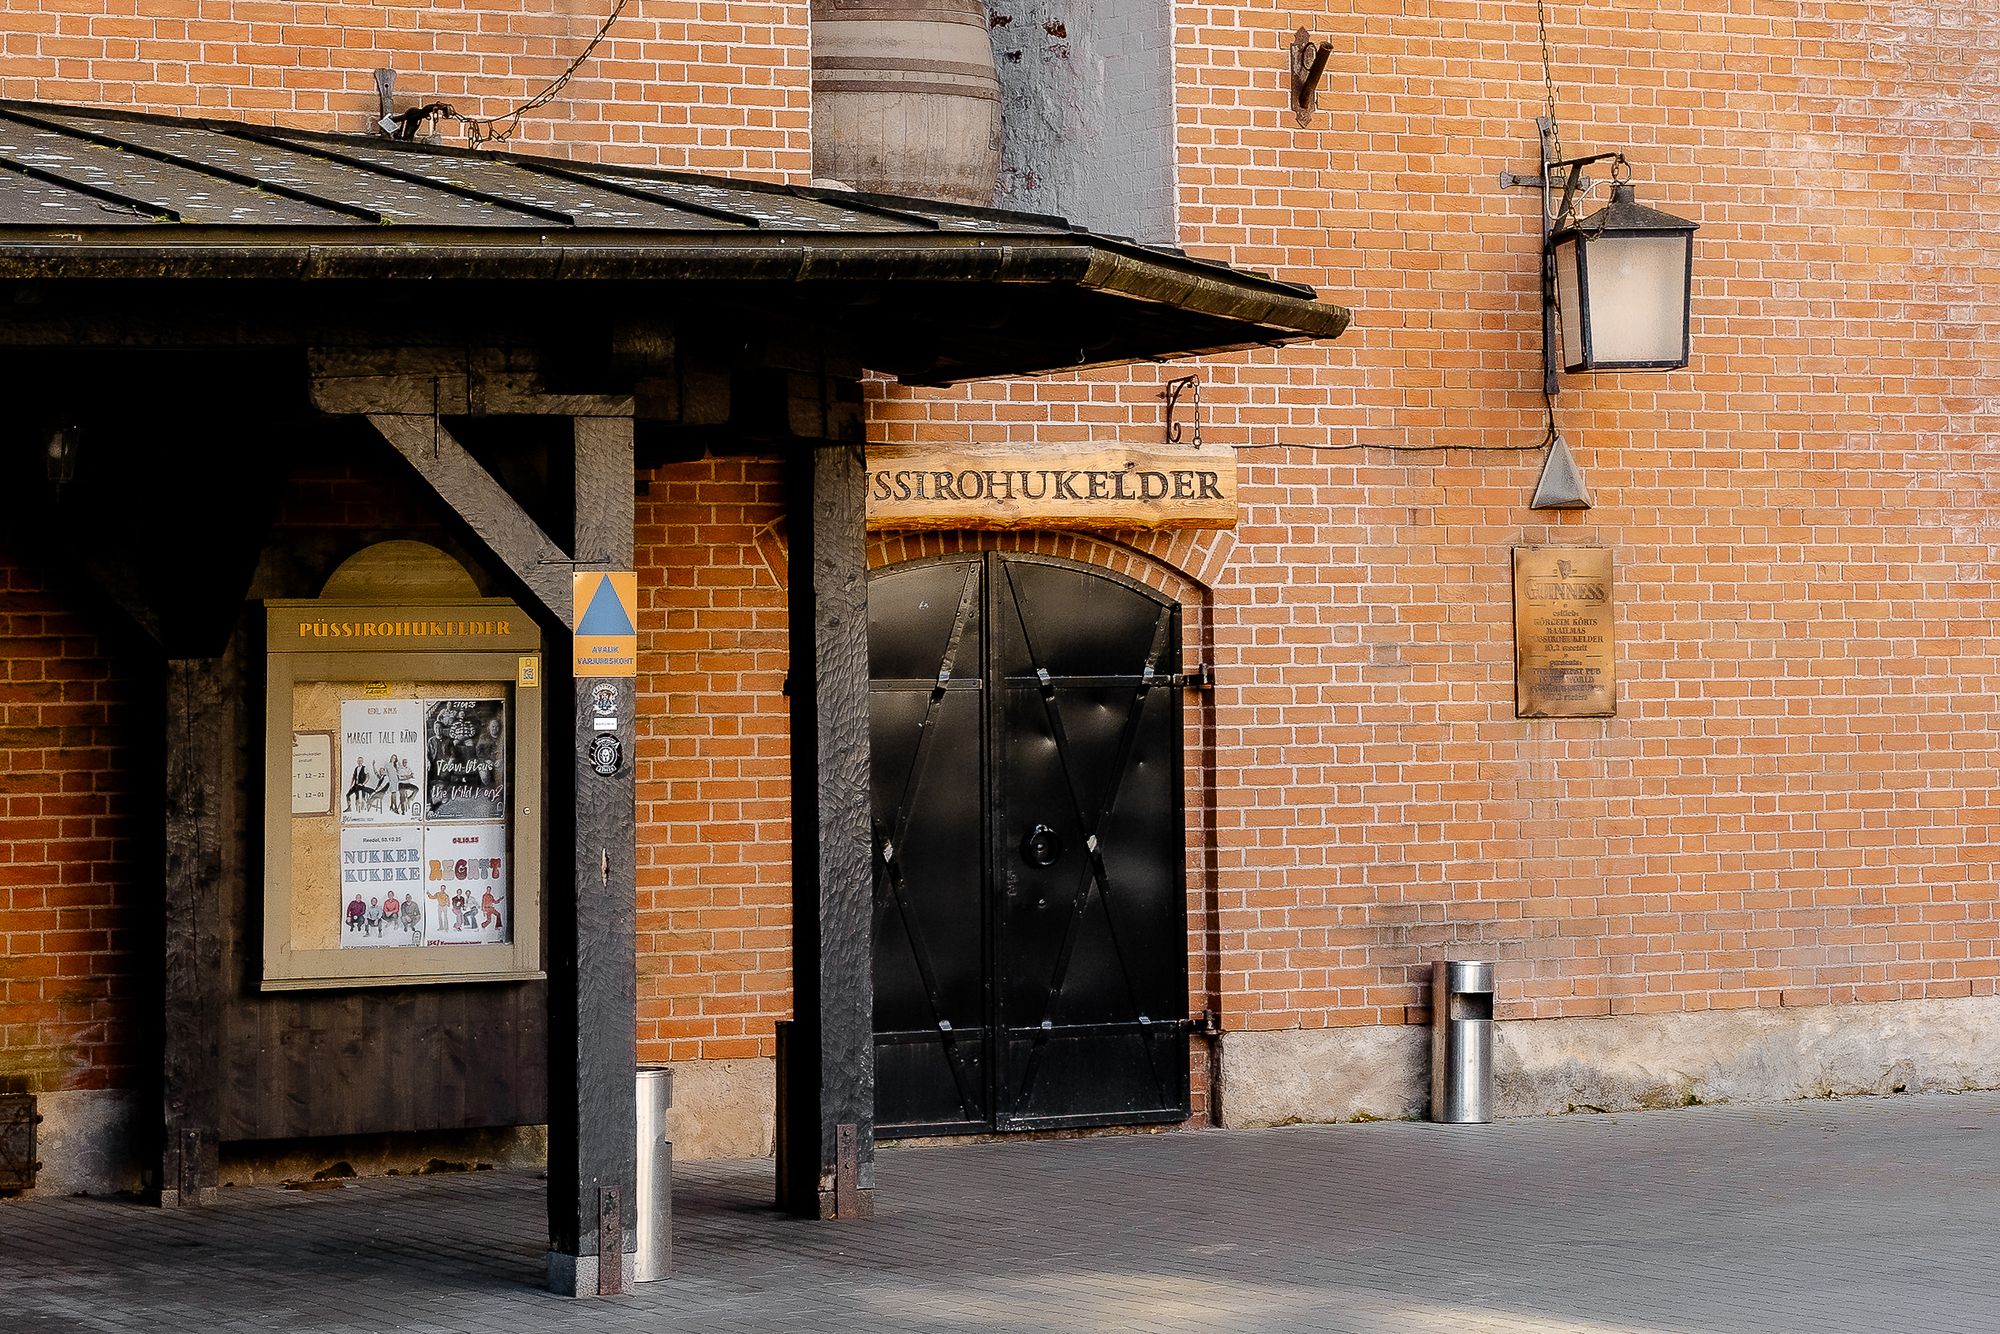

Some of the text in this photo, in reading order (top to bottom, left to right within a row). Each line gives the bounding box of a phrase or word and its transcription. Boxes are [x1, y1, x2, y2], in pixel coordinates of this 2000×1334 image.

[1524, 579, 1605, 601] GUINNESS
[299, 619, 511, 638] PÜSSIROHUKELDER
[1546, 627, 1586, 635] MAAILMAS
[591, 645, 619, 653] AVALIK
[577, 657, 633, 665] VARJUMISKOHT
[346, 731, 373, 745] MARGIT
[400, 729, 418, 744] BÄND
[344, 849, 420, 864] NUKKER
[344, 867, 421, 883] KUKEKE
